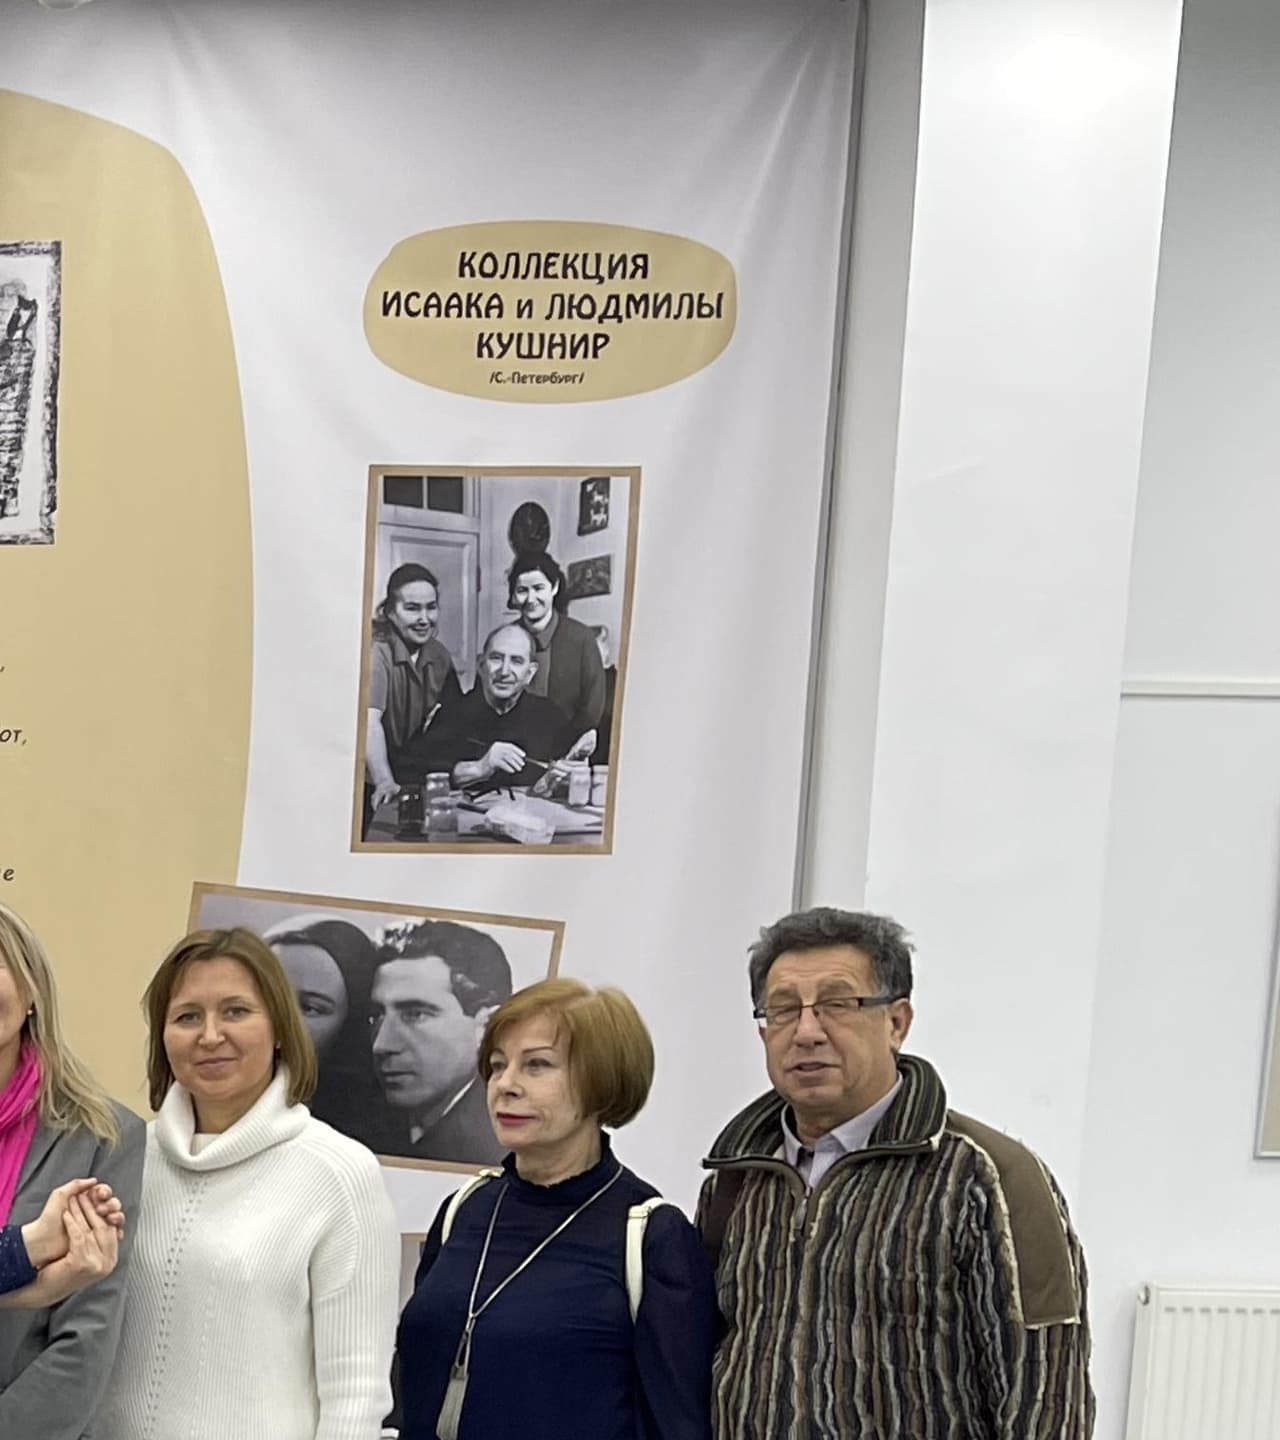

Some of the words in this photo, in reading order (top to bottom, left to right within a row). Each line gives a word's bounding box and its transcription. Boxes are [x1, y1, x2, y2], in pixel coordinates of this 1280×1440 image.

[457, 250, 650, 286] КОЛЛЕКЦИЯ
[381, 290, 505, 320] ИСААКА
[515, 298, 534, 320] и
[544, 291, 725, 325] ЛЮДМИЛЫ
[475, 331, 611, 361] КУШНИР
